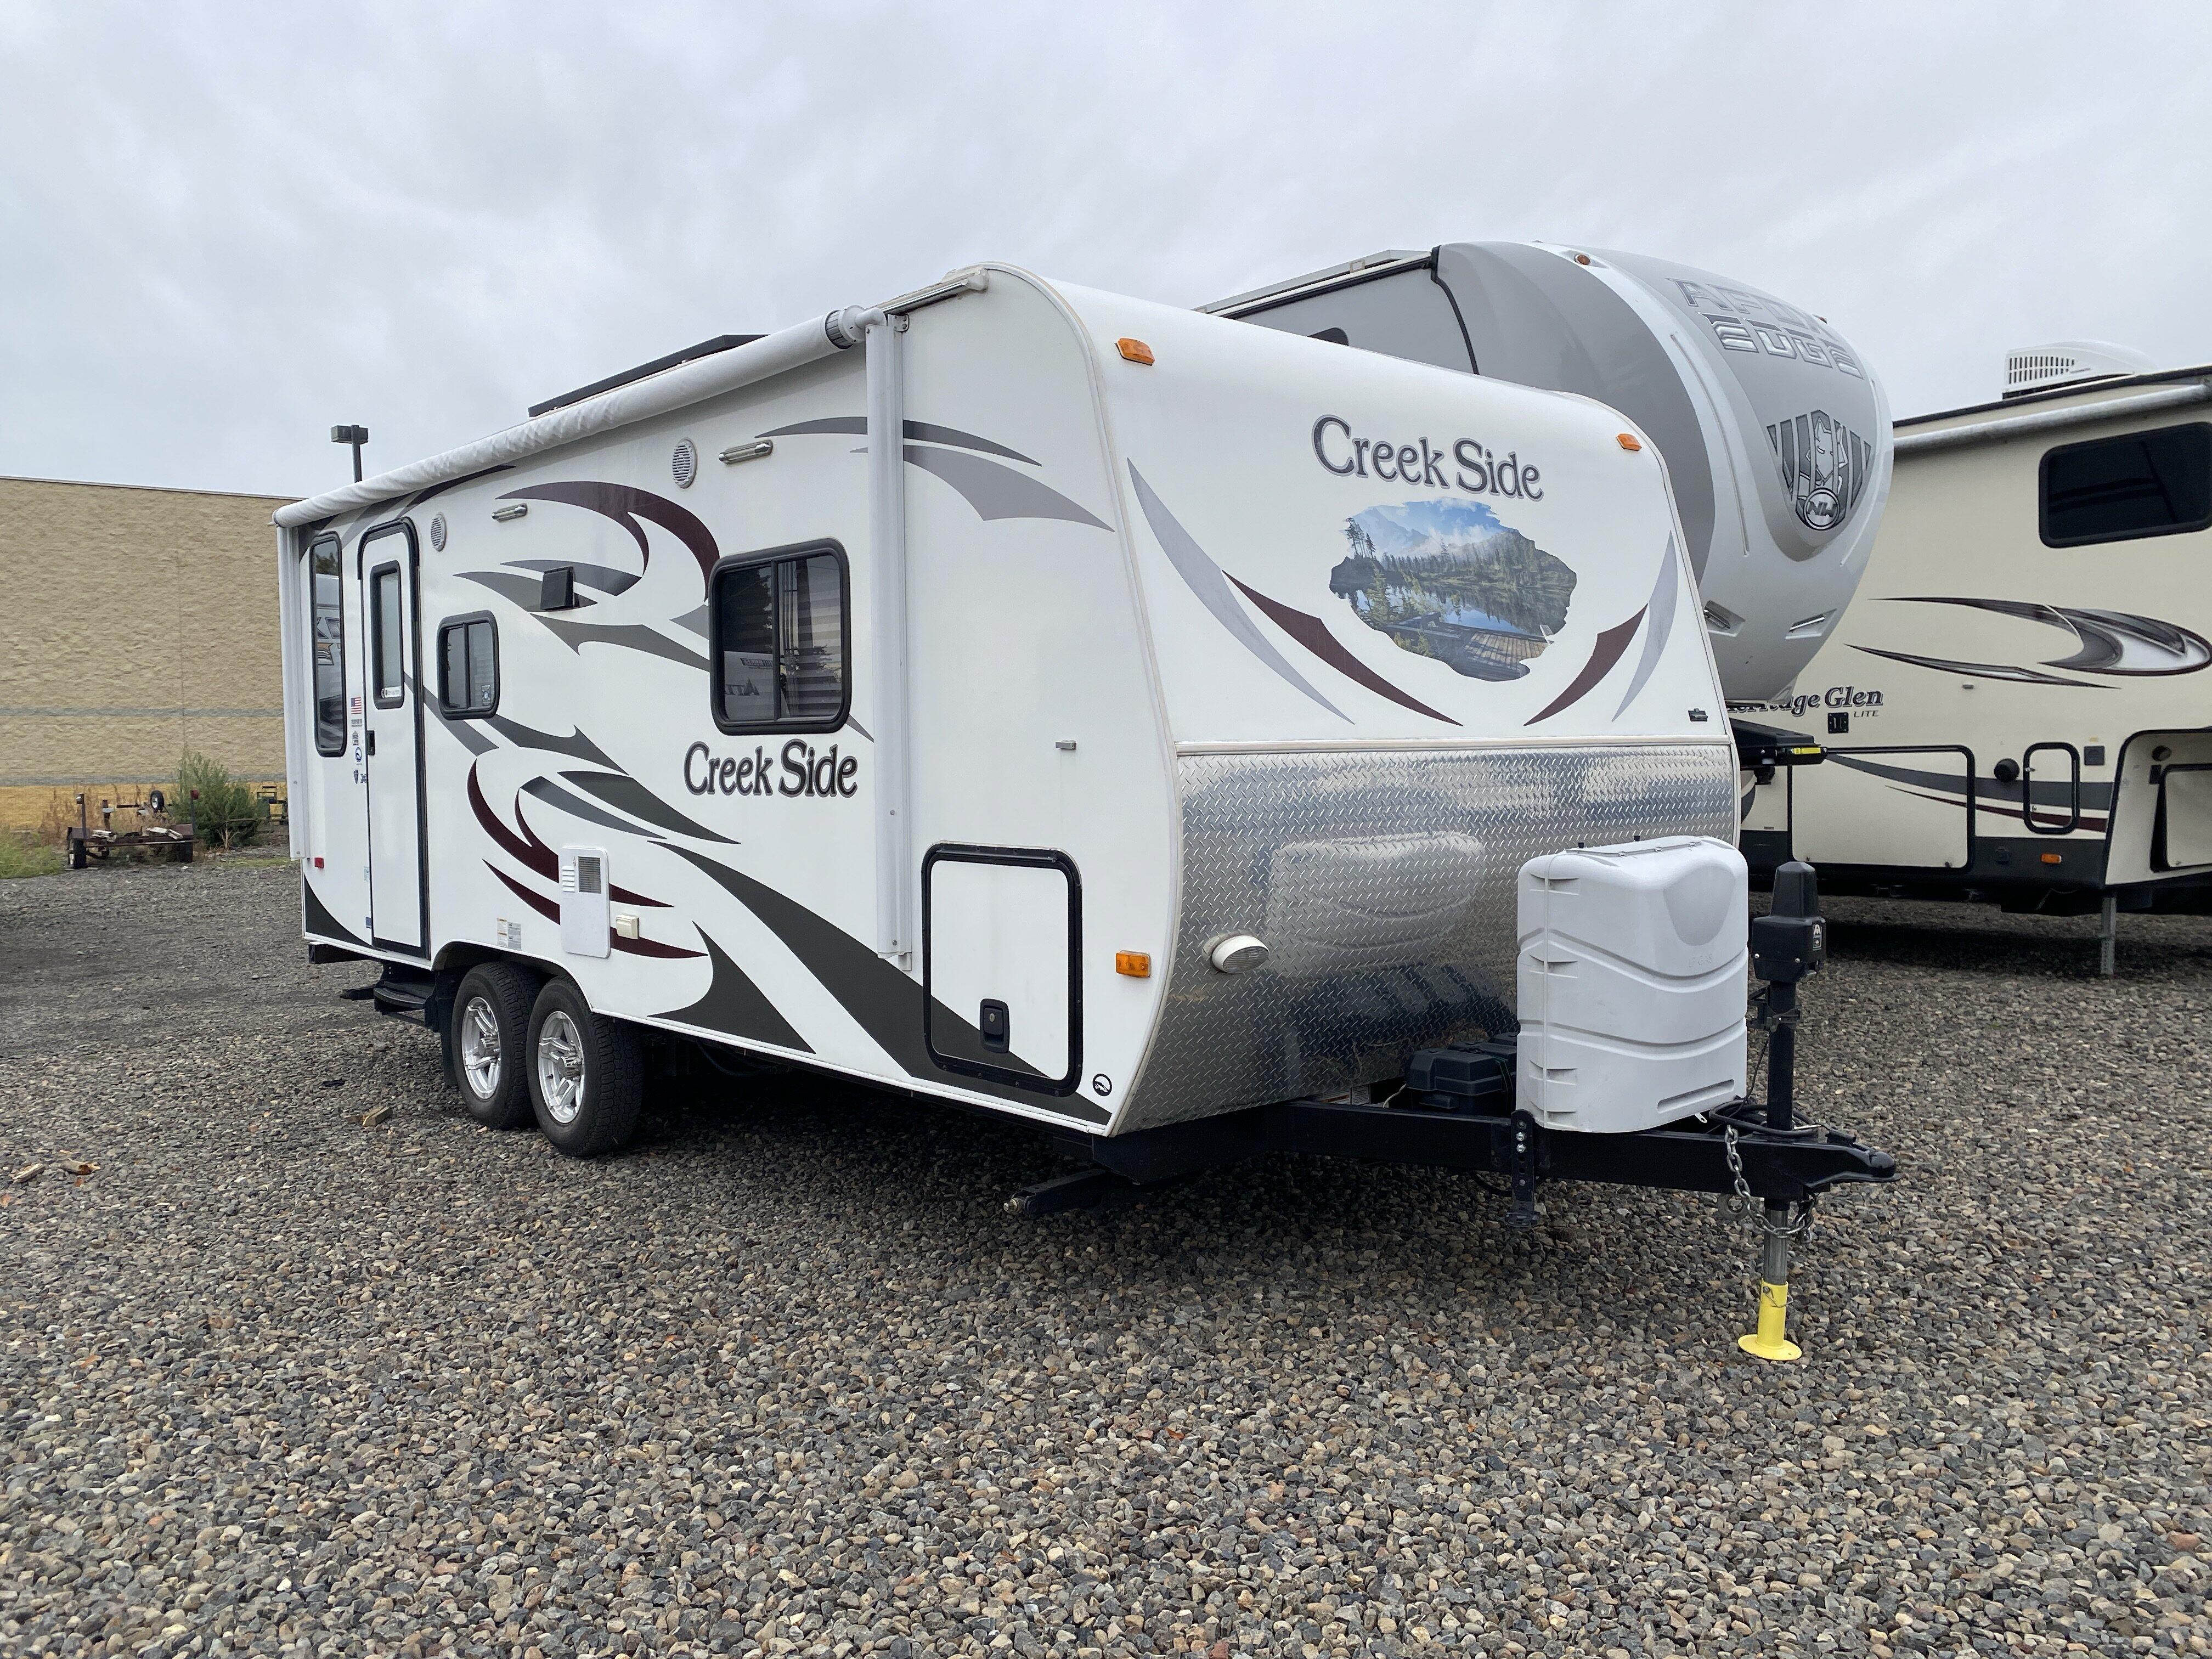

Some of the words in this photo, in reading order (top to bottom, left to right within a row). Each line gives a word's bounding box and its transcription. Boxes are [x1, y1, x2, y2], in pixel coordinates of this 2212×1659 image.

[1312, 414, 1450, 489] Creek
[1453, 437, 1544, 501] Side
[1824, 686, 1883, 708] Glen
[684, 741, 773, 795] Creek
[778, 738, 858, 798] Side
